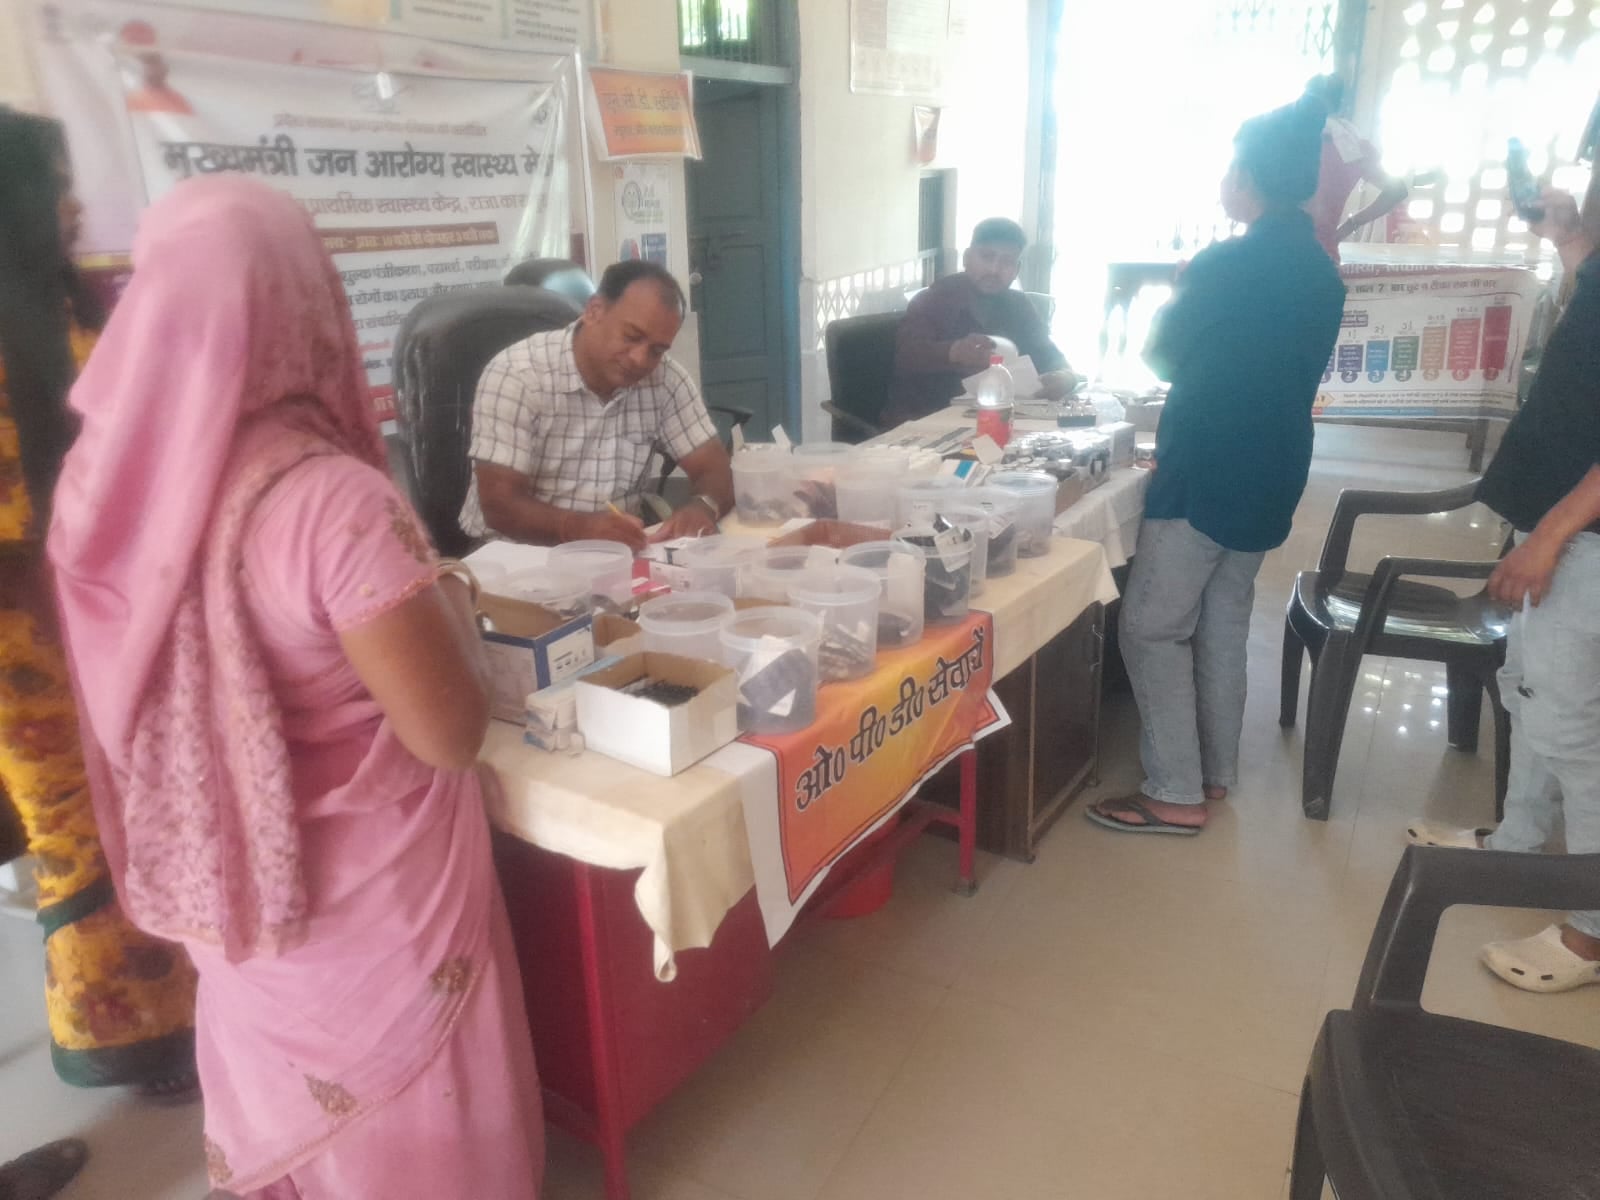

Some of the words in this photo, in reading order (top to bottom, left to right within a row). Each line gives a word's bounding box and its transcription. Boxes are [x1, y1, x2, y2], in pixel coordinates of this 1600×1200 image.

[161, 133, 299, 179] मख्यमंत्री
[303, 148, 357, 177] जन
[365, 141, 445, 178] आरोग्य
[450, 152, 519, 178] स्वास्थ्य
[927, 625, 986, 706] सेवायें
